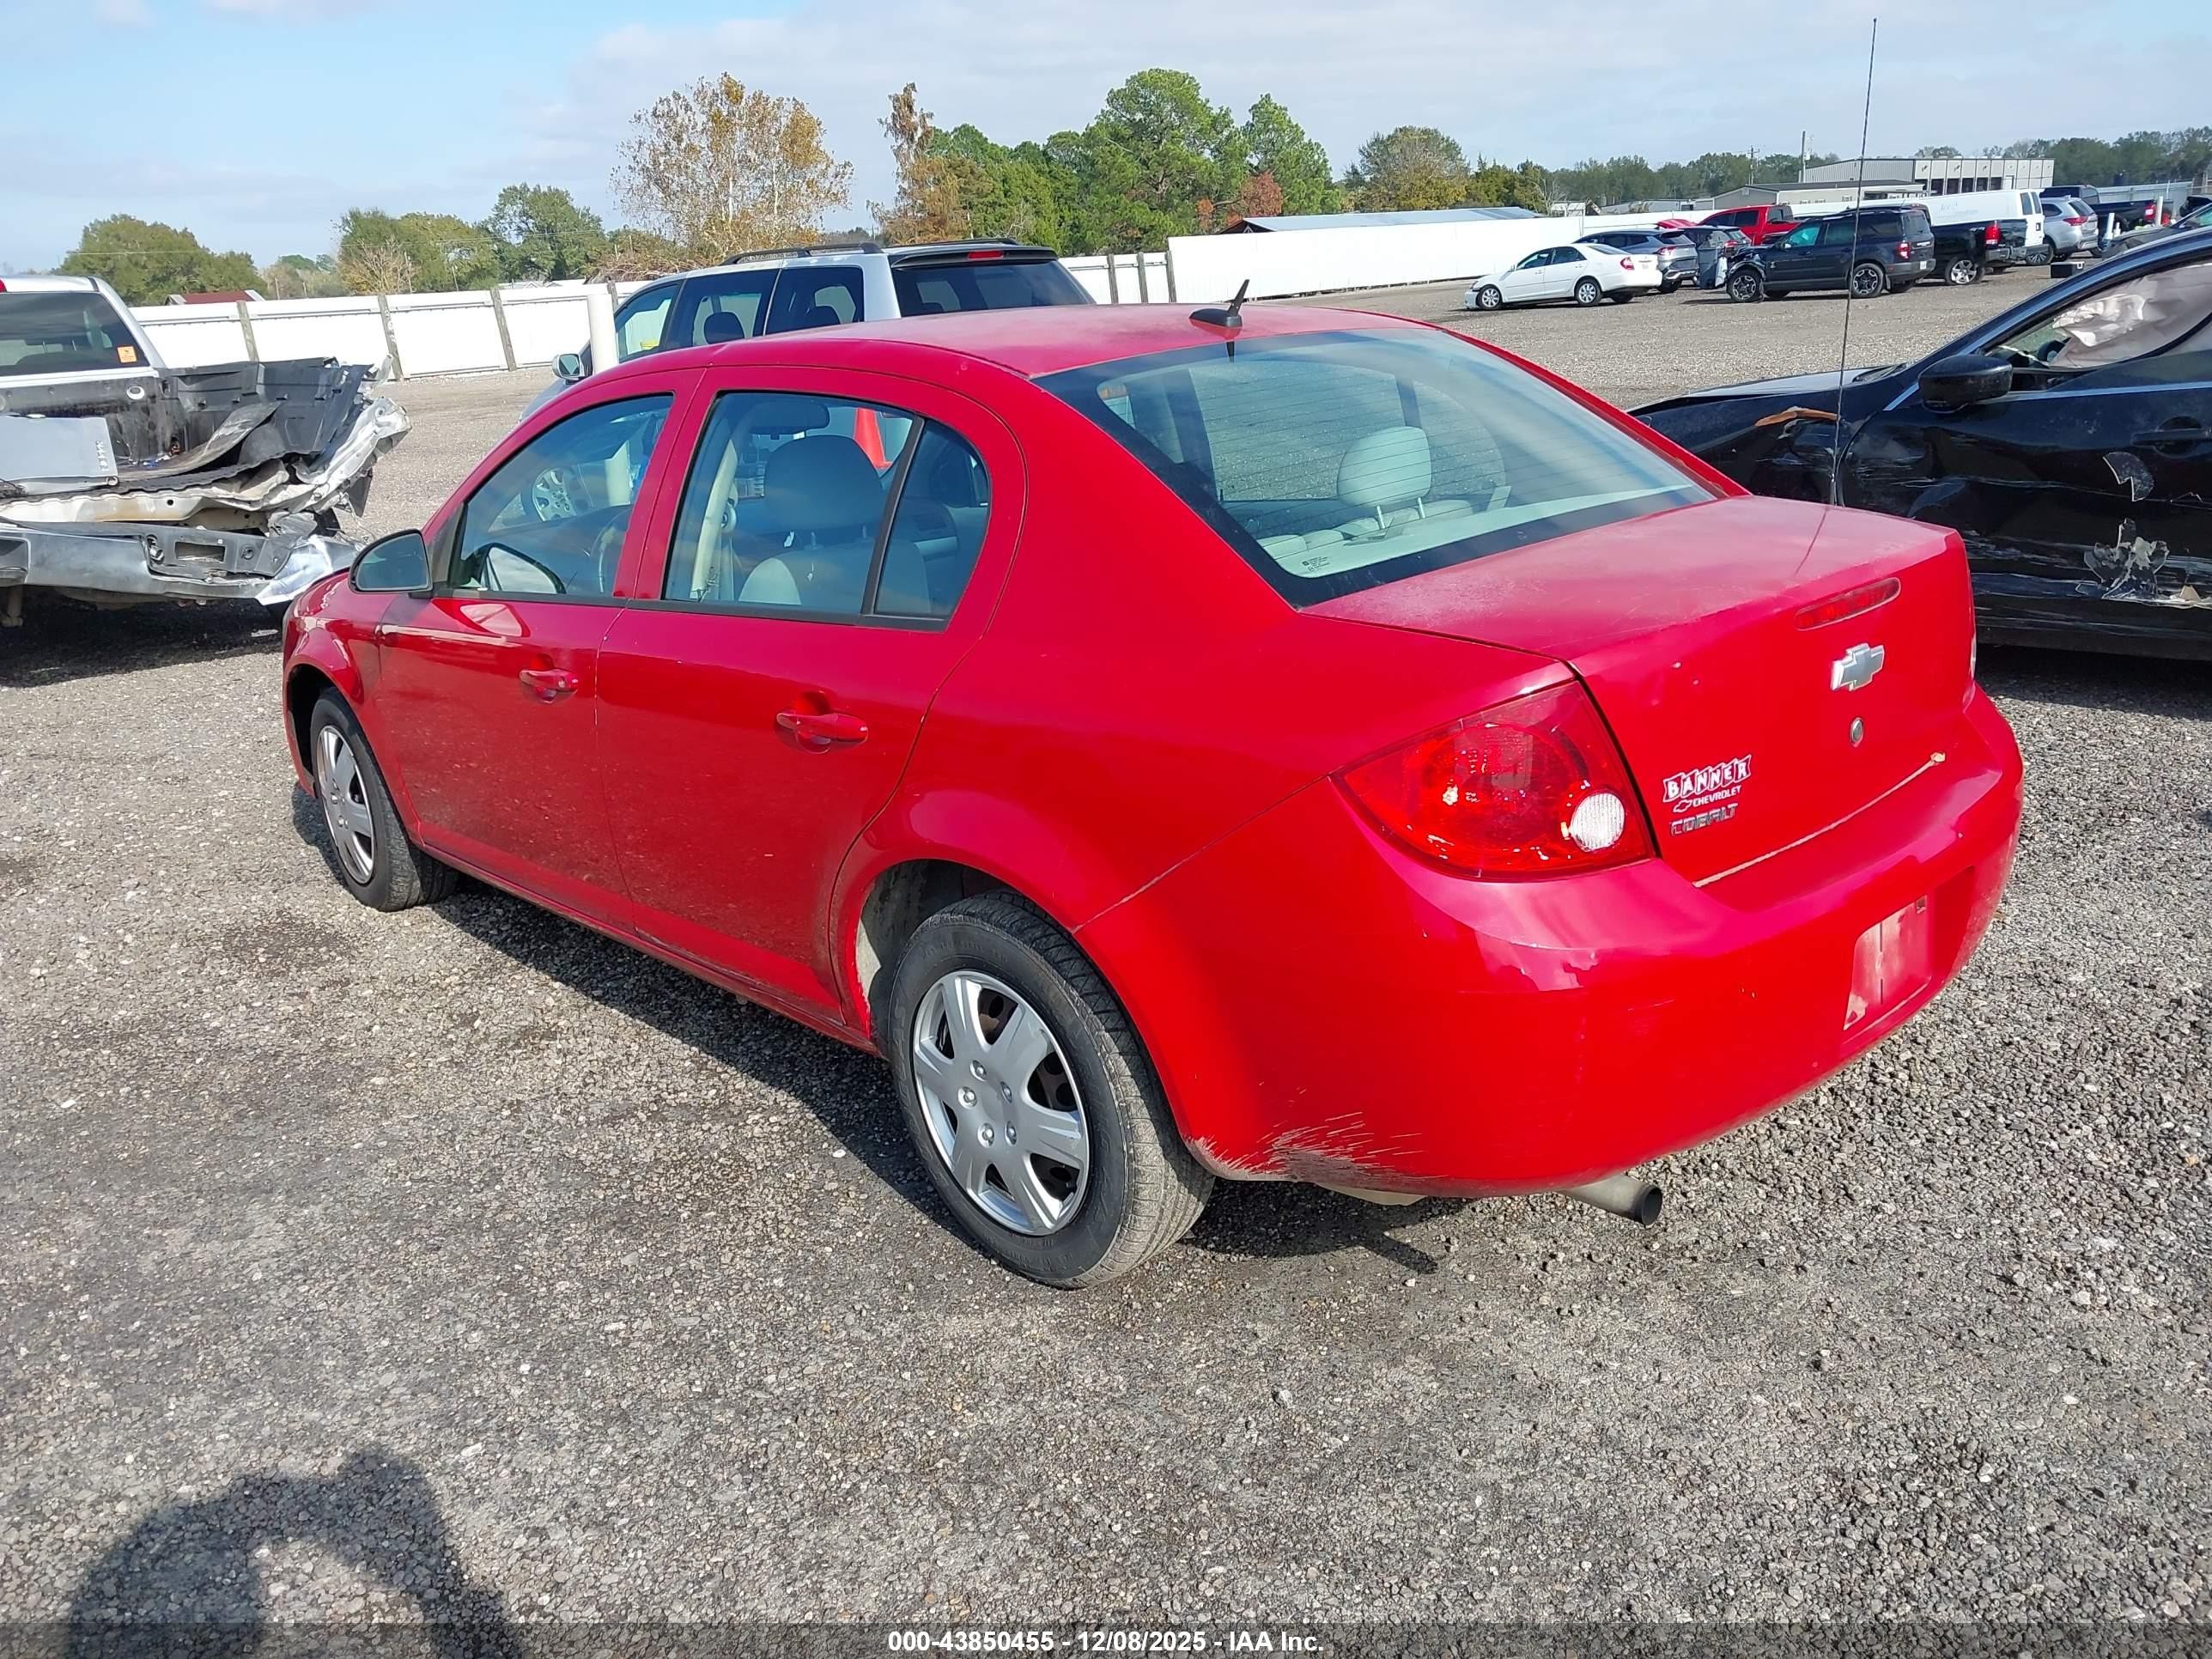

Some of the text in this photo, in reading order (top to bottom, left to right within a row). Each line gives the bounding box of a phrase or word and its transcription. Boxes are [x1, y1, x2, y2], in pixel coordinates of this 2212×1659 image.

[1666, 760, 1748, 799] BANNER
[1692, 785, 1741, 807] CHEVROLET
[1670, 803, 1739, 836] COBALT
